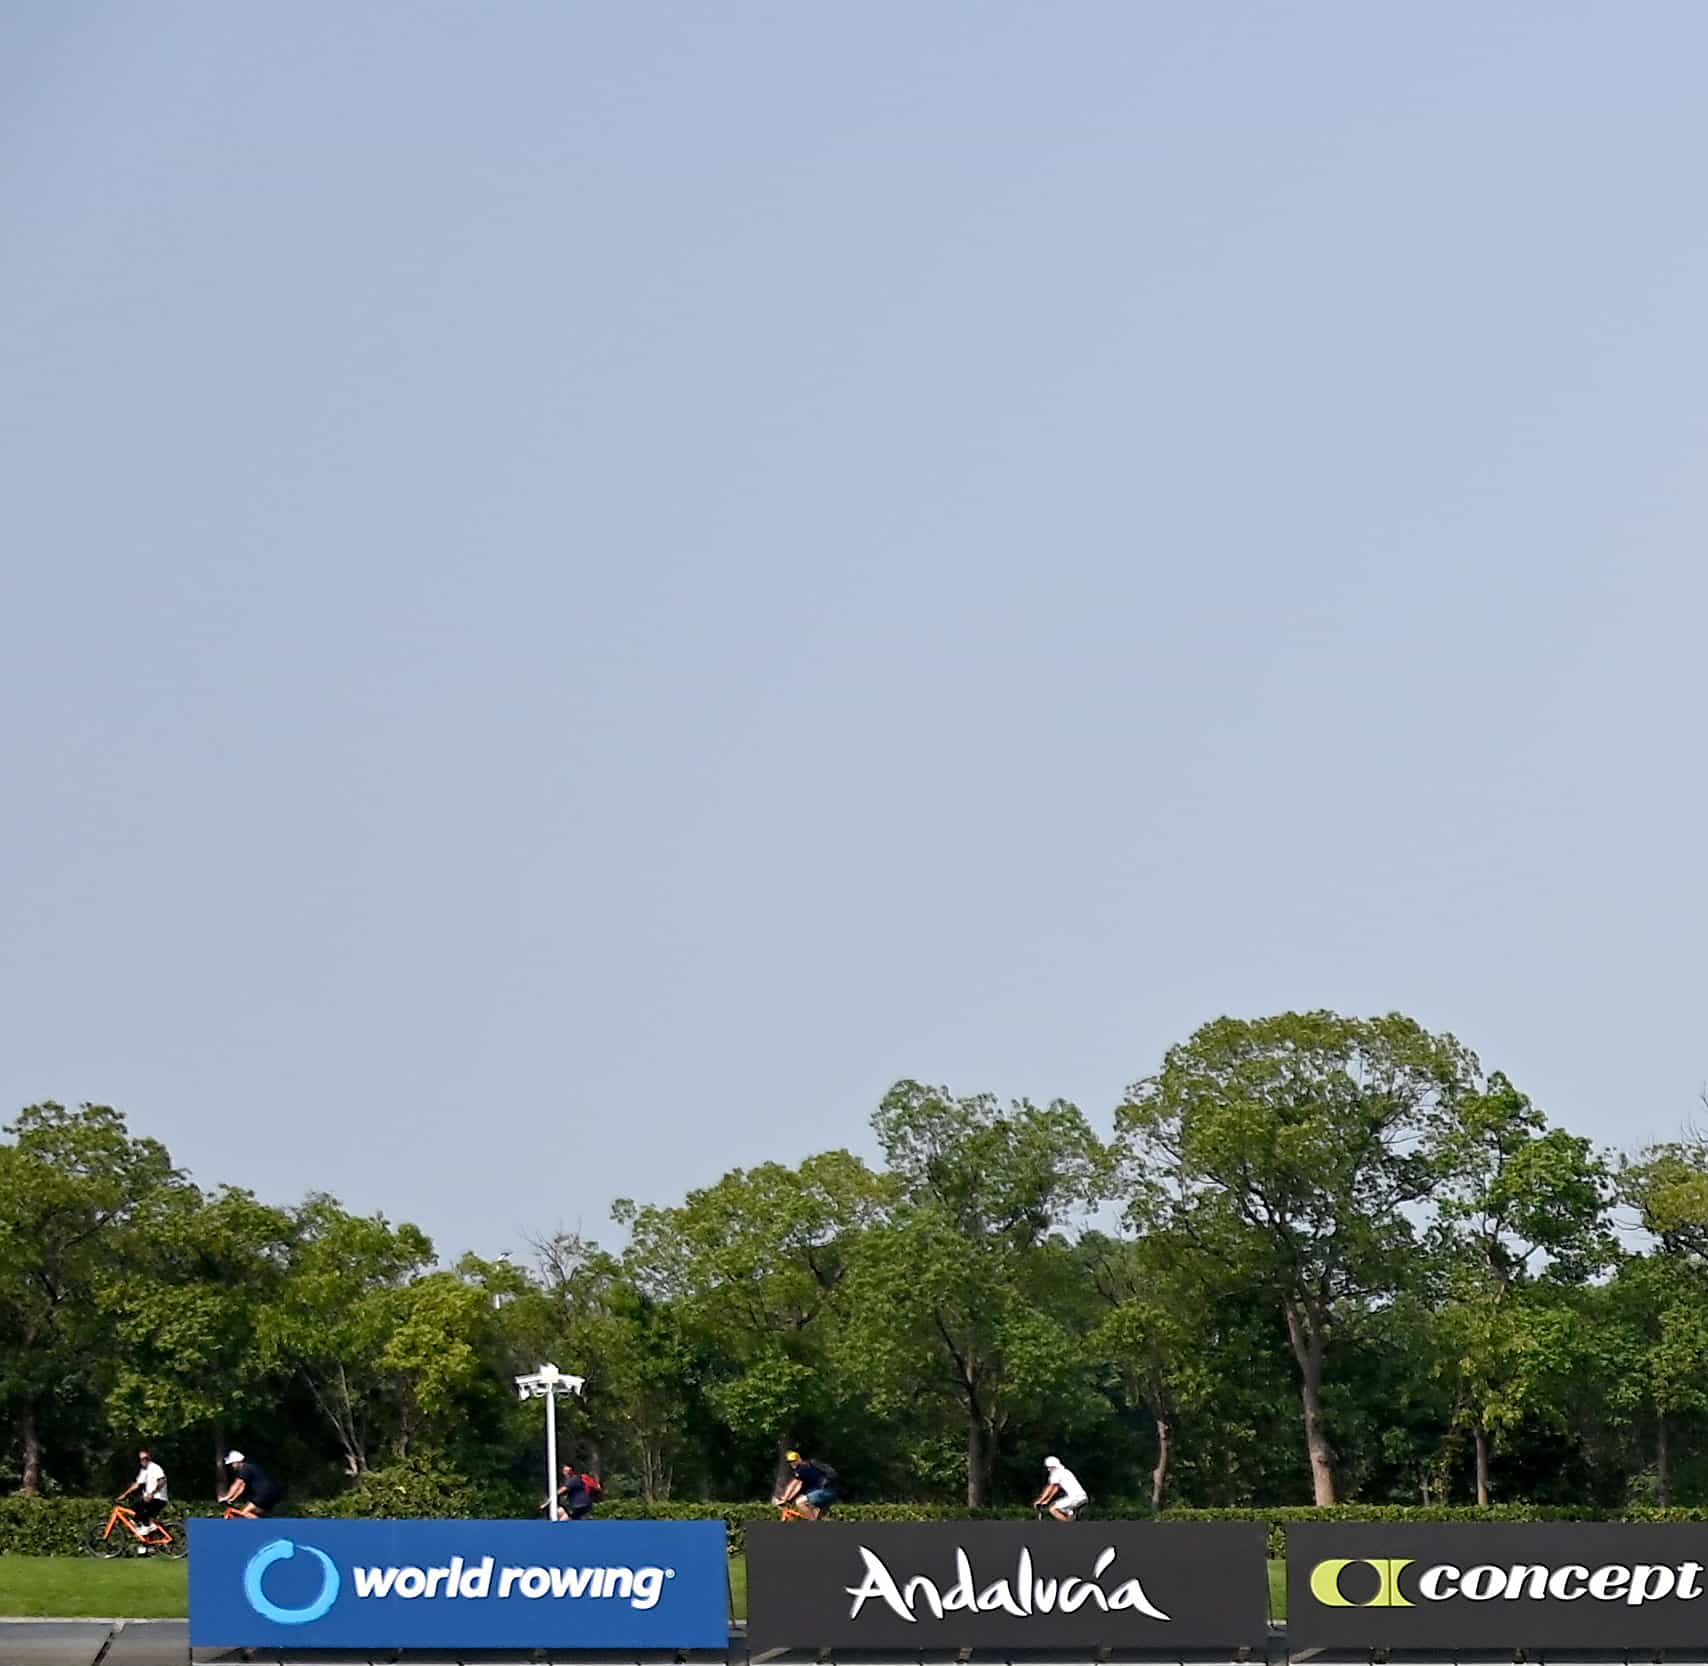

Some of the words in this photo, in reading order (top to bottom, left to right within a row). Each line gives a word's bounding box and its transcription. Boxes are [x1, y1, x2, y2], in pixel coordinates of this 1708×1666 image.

[354, 1557, 494, 1599] world
[499, 1564, 664, 1609] rowing
[846, 1546, 1170, 1621] Andalucía
[1419, 1560, 1703, 1606] concept
